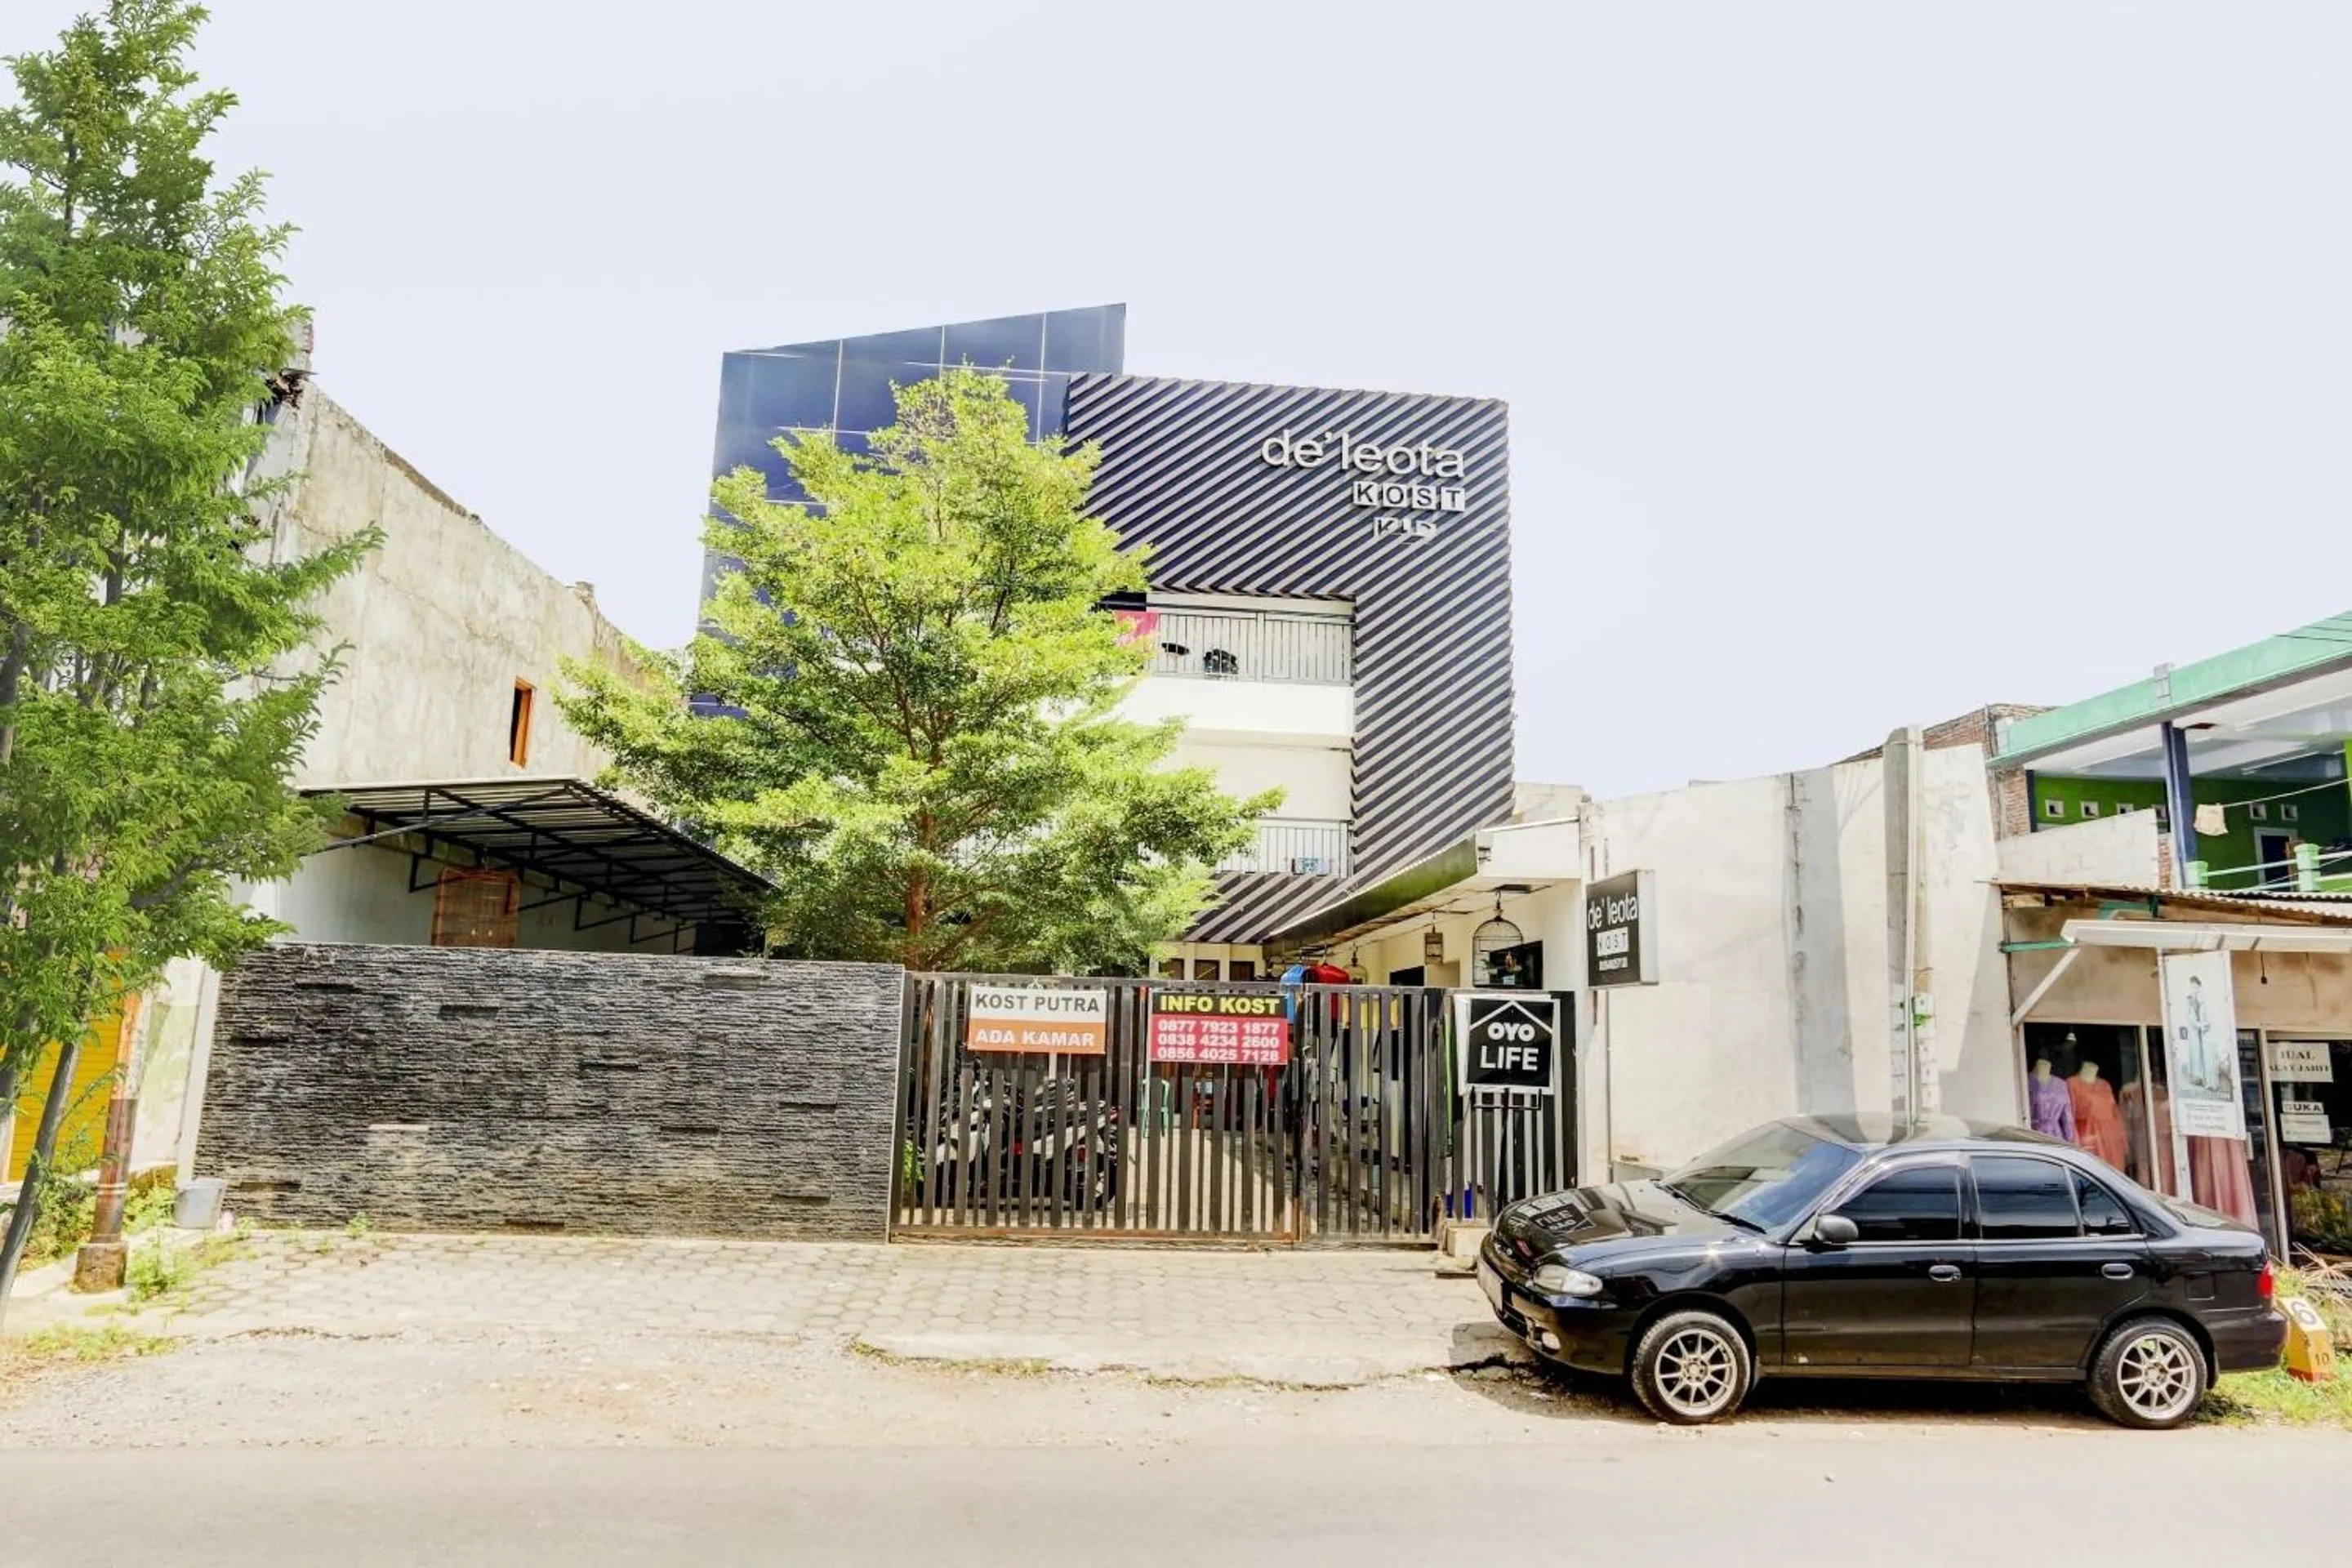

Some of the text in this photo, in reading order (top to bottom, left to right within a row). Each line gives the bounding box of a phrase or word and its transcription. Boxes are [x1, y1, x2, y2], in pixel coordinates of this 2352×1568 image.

[1262, 430, 1464, 478] de'leota
[1355, 483, 1462, 510] KOST
[975, 993, 1099, 1012] KOST PUTRA
[1160, 996, 1280, 1014] INFO KOST
[1158, 1020, 1280, 1035] 0877 7923 1877
[1487, 1022, 1535, 1042] OYO
[976, 1028, 1095, 1047] ADA KAMAR
[1158, 1033, 1196, 1045] 0838
[1200, 1034, 1237, 1047] 4234
[1157, 1046, 1280, 1062] 0856 4025 7128
[1480, 1045, 1539, 1071] LIFE
[2291, 1301, 2318, 1325] 6
